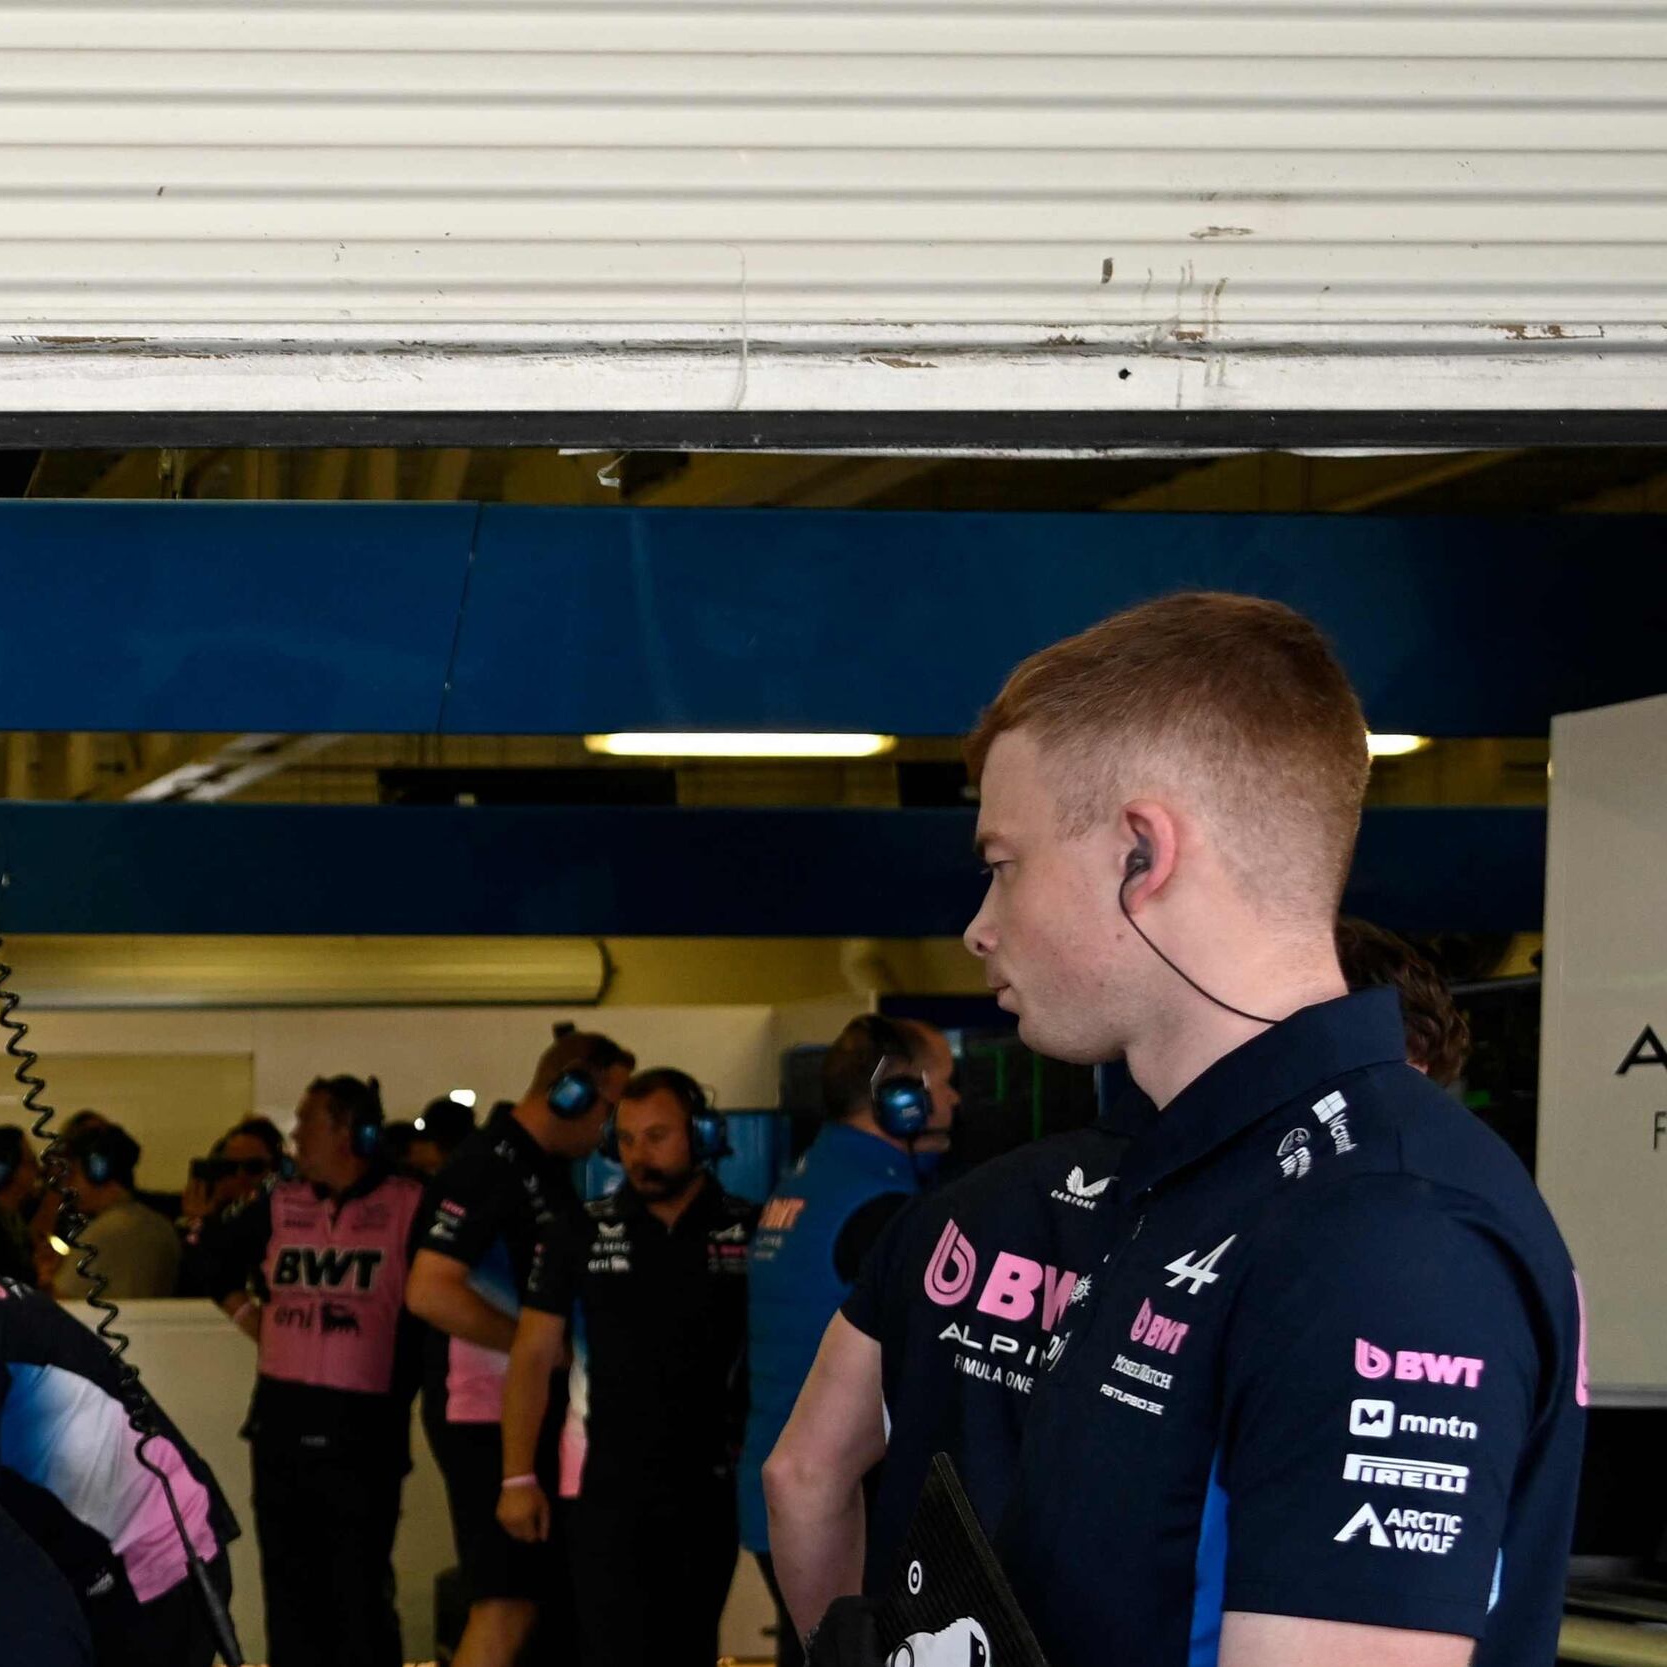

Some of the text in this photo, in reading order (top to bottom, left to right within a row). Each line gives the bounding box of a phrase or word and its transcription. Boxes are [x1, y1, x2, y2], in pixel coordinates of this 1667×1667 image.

[271, 1246, 385, 1291] BWT
[975, 1250, 1079, 1333] BW
[1142, 1313, 1190, 1355] BWT
[1005, 1369, 1034, 1395] ONE
[1394, 1350, 1484, 1388] BWT
[1399, 1412, 1478, 1440] mntn
[1342, 1453, 1470, 1494] PIRELLI
[1384, 1507, 1463, 1535] ARCTIC
[1393, 1529, 1456, 1555] WOLF
